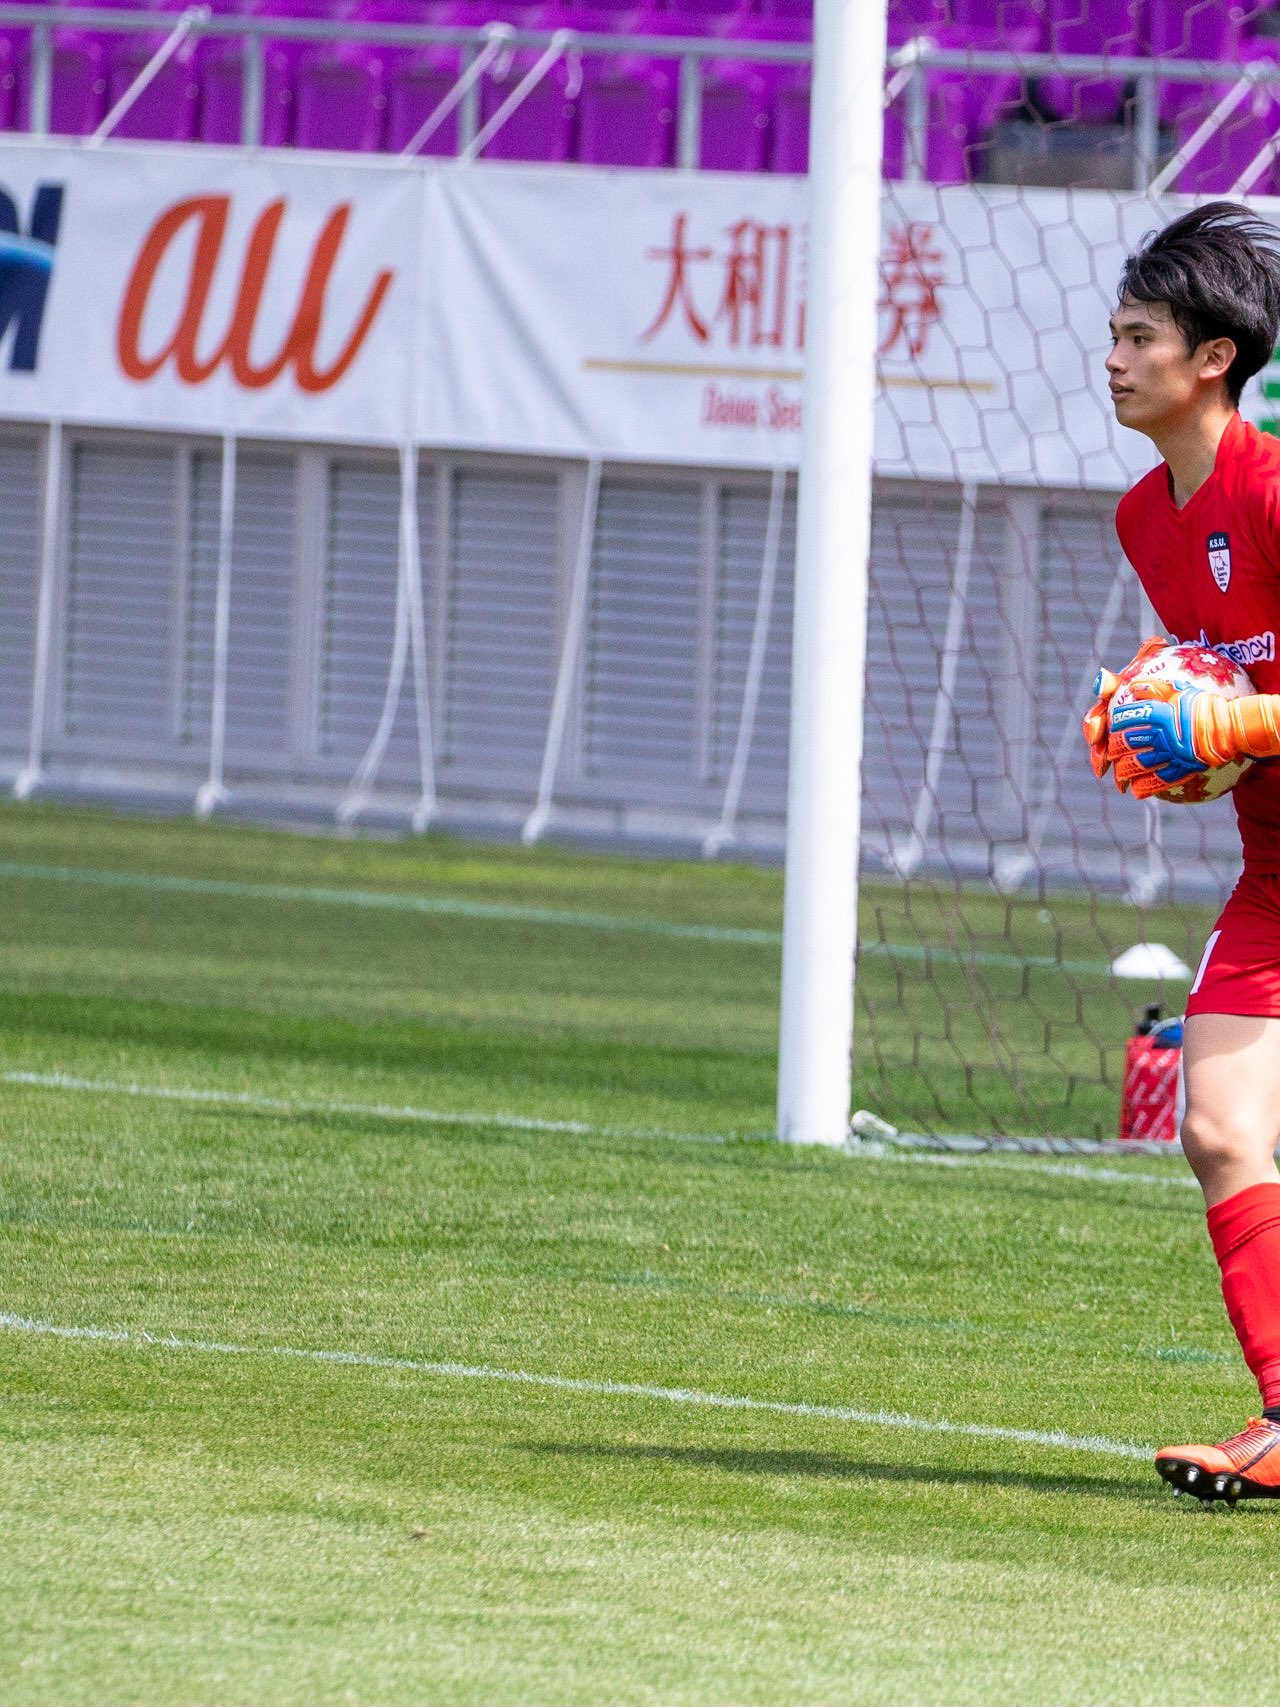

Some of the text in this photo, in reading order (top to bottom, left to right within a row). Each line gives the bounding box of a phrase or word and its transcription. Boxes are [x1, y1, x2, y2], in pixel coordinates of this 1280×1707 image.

[117, 194, 394, 393] au
[638, 212, 943, 356] 大和券
